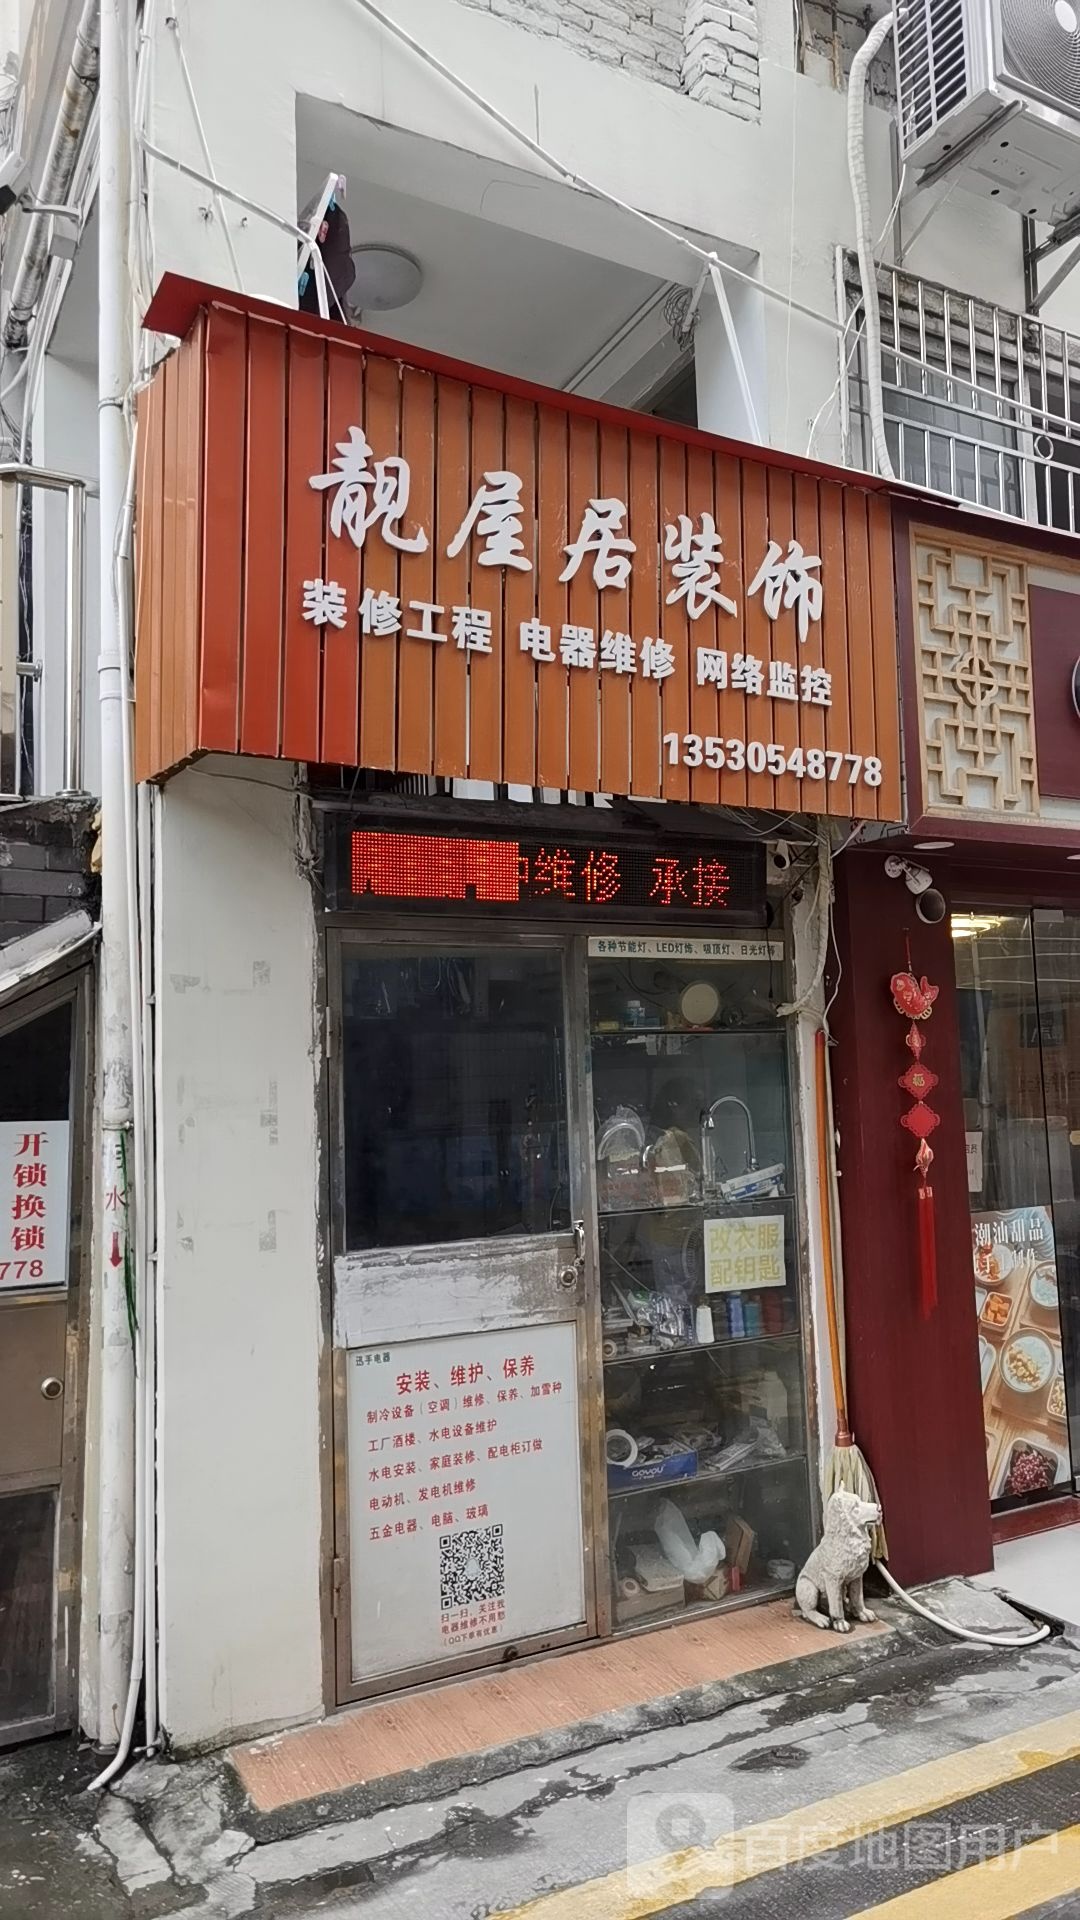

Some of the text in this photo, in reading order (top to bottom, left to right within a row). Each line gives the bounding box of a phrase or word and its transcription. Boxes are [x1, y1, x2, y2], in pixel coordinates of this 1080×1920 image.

[308, 425, 823, 643] 靓屋居装饰
[302, 577, 834, 707] 装修工程 电器维修 网络监控
[663, 731, 883, 787] 13530548778
[648, 856, 731, 908] 承接
[11, 1131, 49, 1252] 开锁换锁
[709, 1222, 779, 1253] 改衣服
[974, 1217, 1044, 1247] 潮汕甜品
[0, 1259, 43, 1281] 778
[709, 1254, 782, 1287] 配钥匙
[396, 1354, 535, 1396] 安装、维护、保养
[367, 1418, 497, 1453] 工厂酒楼、水电设备维护
[367, 1437, 543, 1483] 水电安装、家庭装修、配电柜订做
[369, 1477, 476, 1511] 电动机、发电机维修
[368, 1503, 489, 1541] 五金电器、电脑、玻璃
